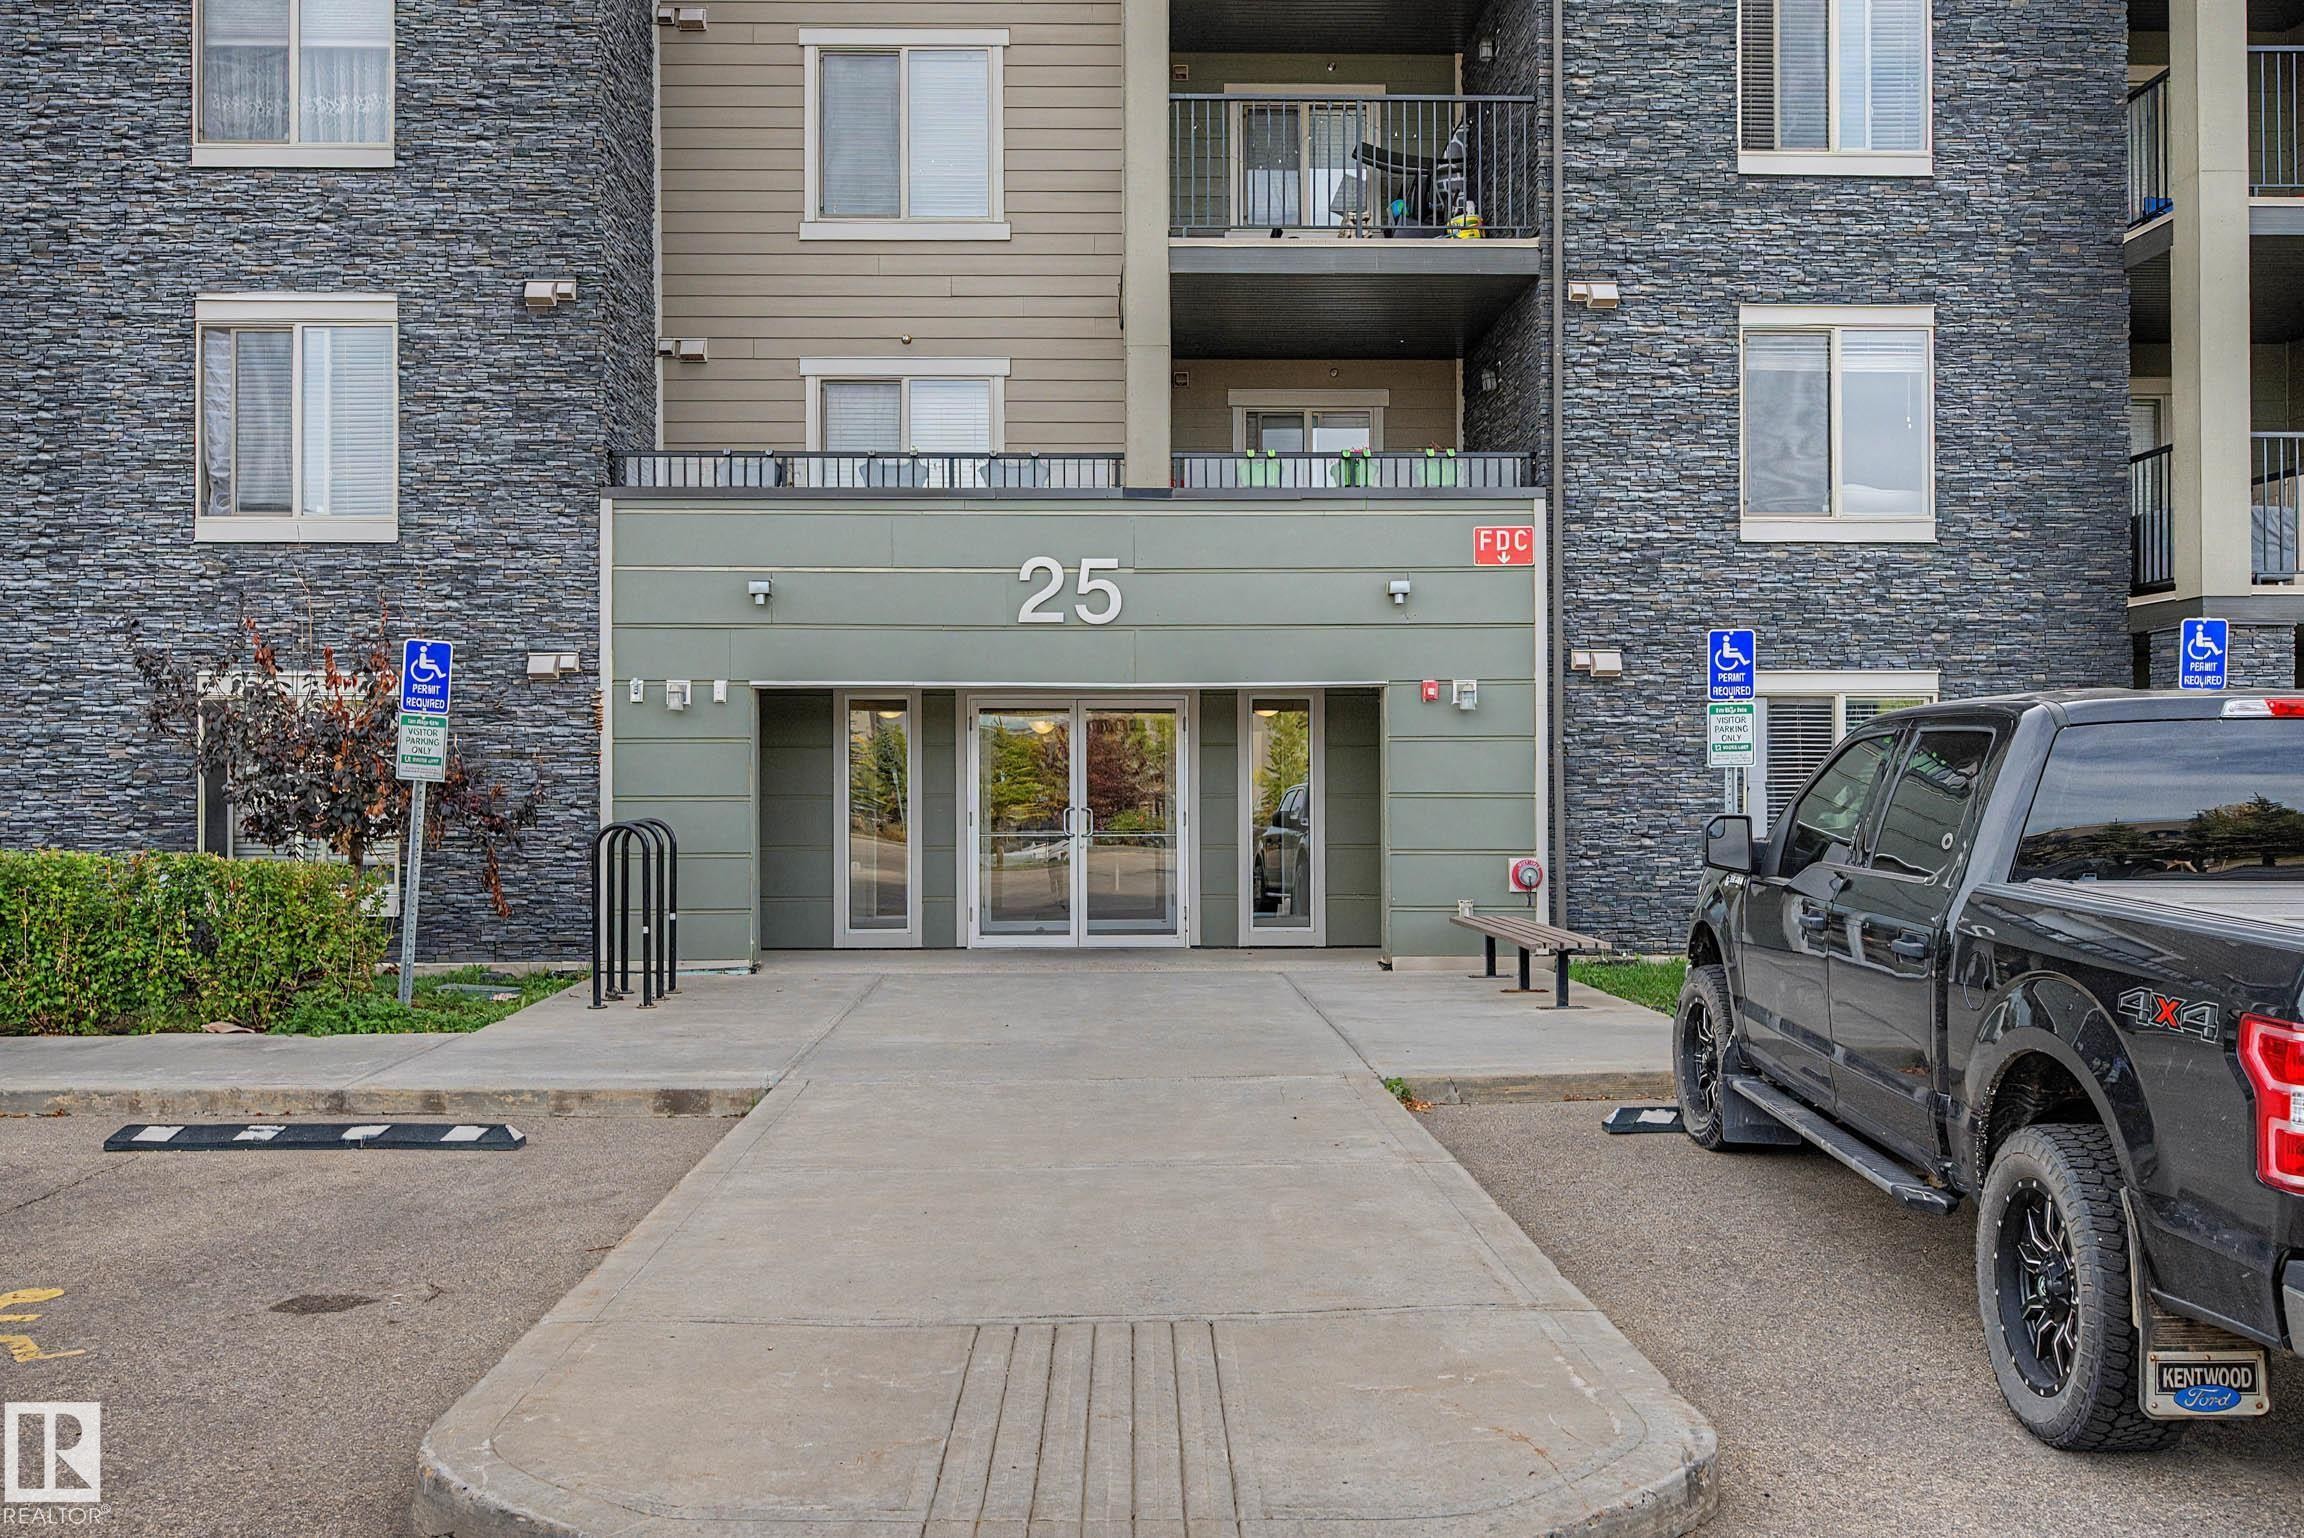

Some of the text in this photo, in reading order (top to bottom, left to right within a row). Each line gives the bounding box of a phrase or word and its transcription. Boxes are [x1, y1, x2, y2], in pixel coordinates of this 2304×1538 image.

[1480, 530, 1528, 551] FDC
[1018, 556, 1122, 625] 25
[2189, 661, 2218, 672] PERMIT
[1717, 672, 1746, 683] PERMIT
[2184, 675, 2222, 685] REQUIRED
[412, 683, 441, 695] PERMIT
[1712, 686, 1751, 697] REQUIRED
[406, 697, 445, 709] REQUIRED
[1716, 716, 1747, 724] VISITOR
[407, 727, 439, 737] VISITOR
[1714, 725, 1749, 733] PARKING
[405, 736, 440, 746] PARKING
[1721, 734, 1742, 742] ONLY
[411, 746, 432, 755] ONLY
[2162, 1367, 2253, 1388] KENTWOOD
[2184, 1388, 2231, 1407] Ford
